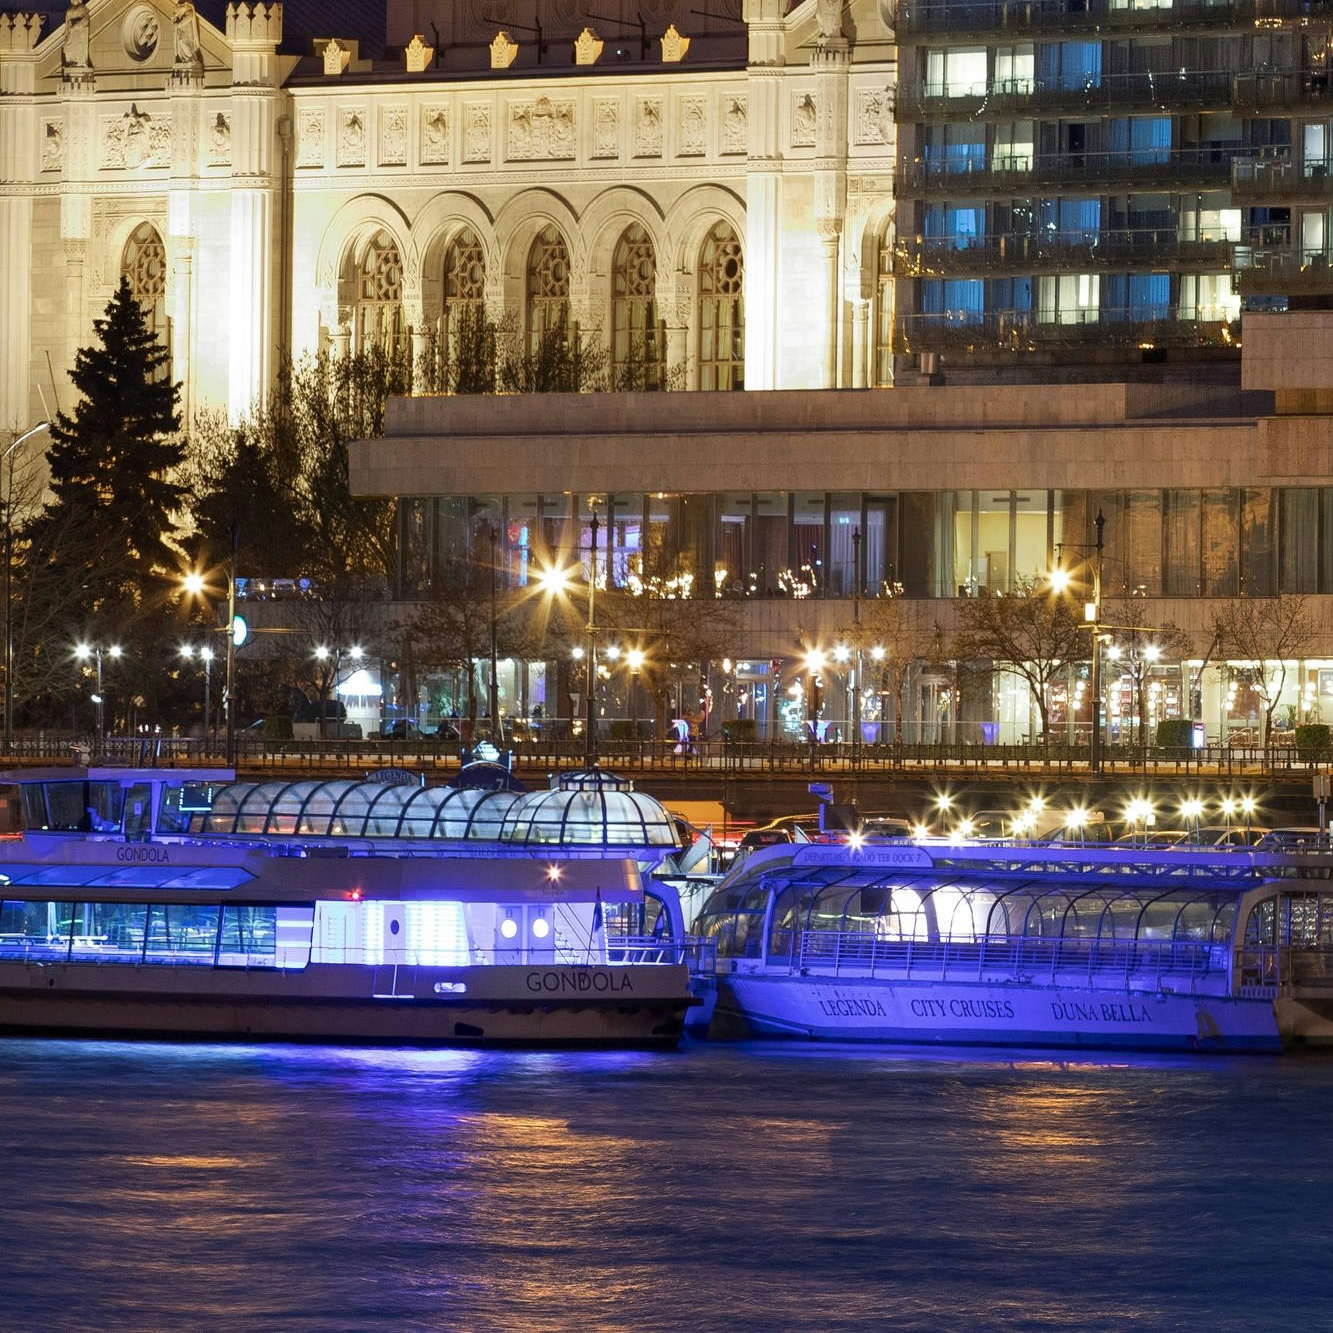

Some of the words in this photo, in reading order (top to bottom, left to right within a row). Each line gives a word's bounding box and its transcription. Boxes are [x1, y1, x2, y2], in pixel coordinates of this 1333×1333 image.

[117, 847, 170, 863] GONDOLA
[526, 972, 634, 992] GONDOLA
[819, 1000, 887, 1018] LEGENDA
[911, 1000, 947, 1018] CITY
[951, 1000, 1015, 1019] CRUISES
[1052, 1002, 1098, 1021] DUNA
[1100, 1003, 1152, 1022] BELLA
